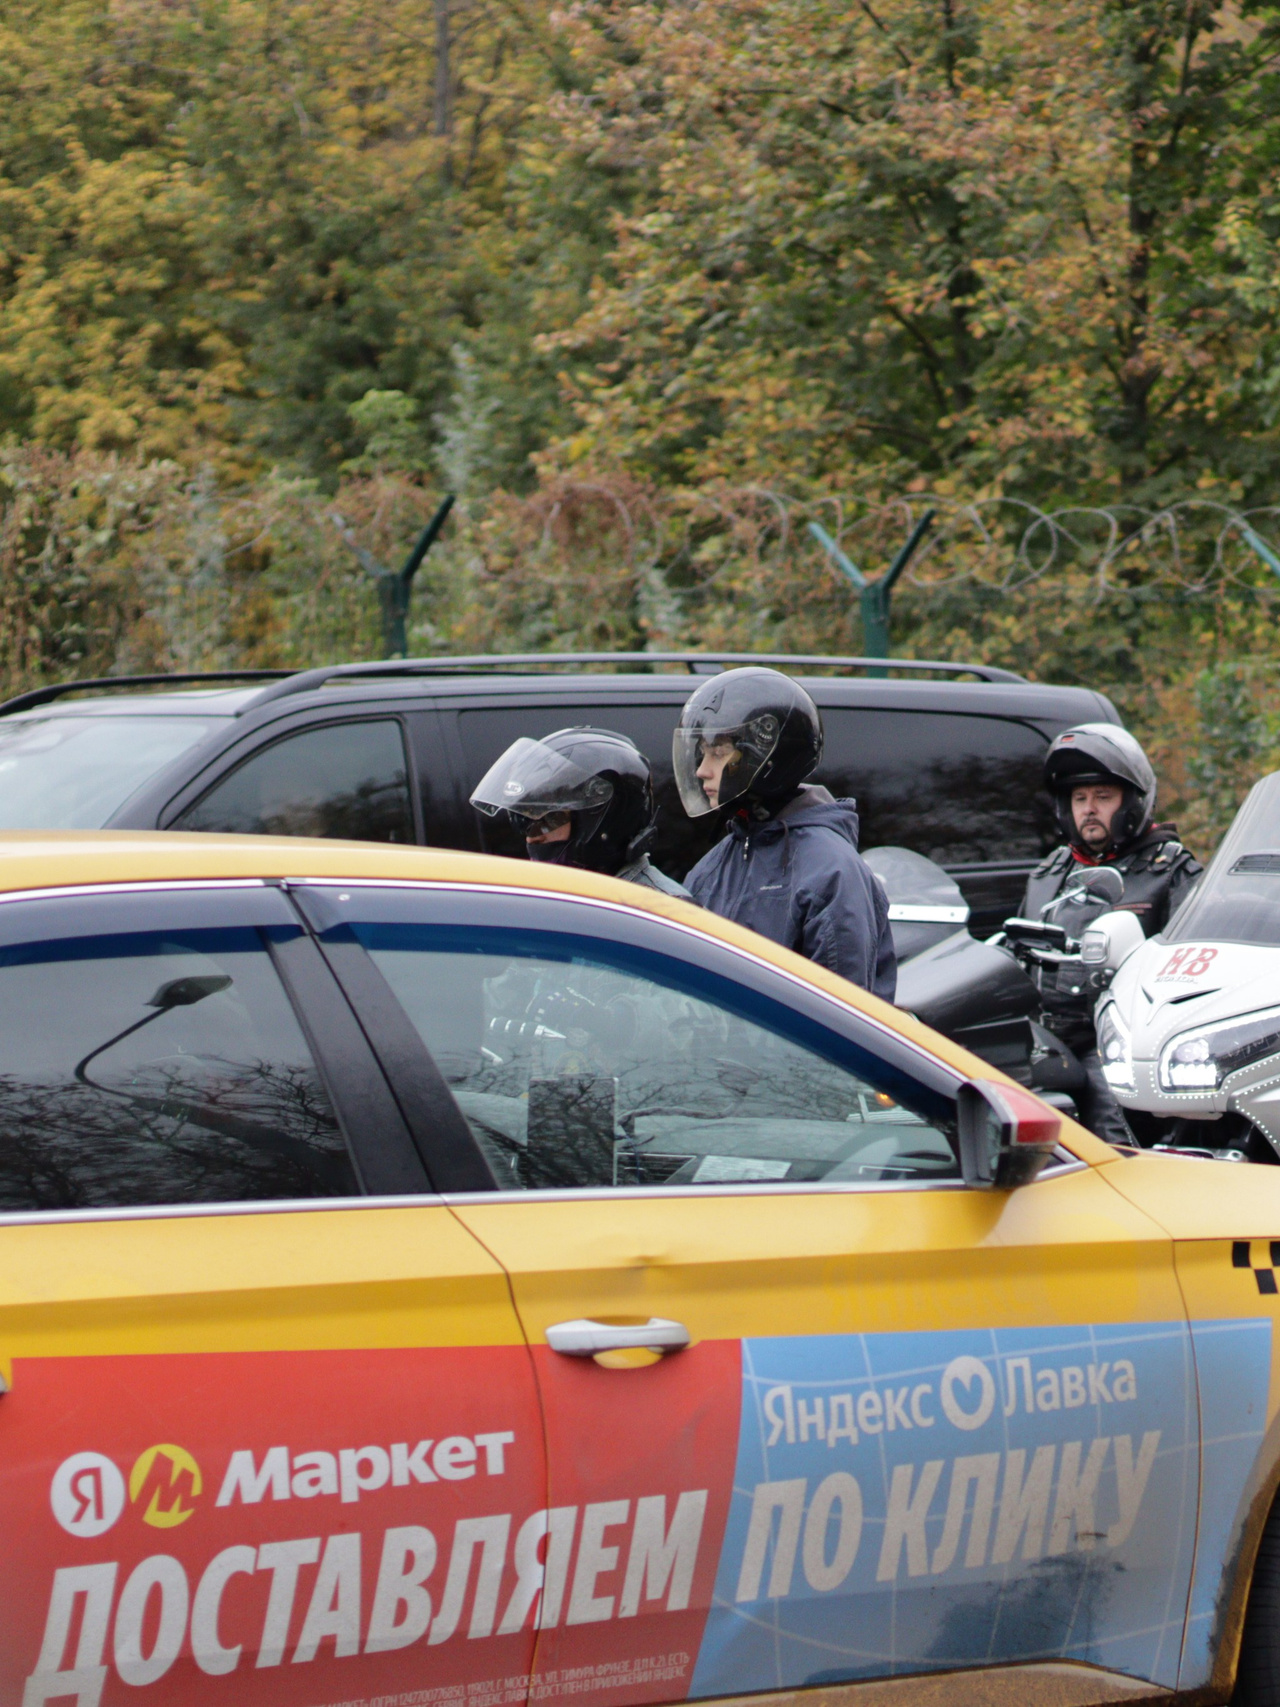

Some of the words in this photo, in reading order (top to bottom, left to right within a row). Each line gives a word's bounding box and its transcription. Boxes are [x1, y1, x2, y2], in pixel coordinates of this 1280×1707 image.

[763, 1384, 933, 1448] Яндекс
[1004, 1357, 1138, 1416] Лавка
[215, 1431, 515, 1508] Маркет
[735, 1471, 863, 1603] ПО
[876, 1430, 1162, 1583] КЛИКУ
[22, 1489, 709, 1707] ДОСТАВЛЯЕМ
